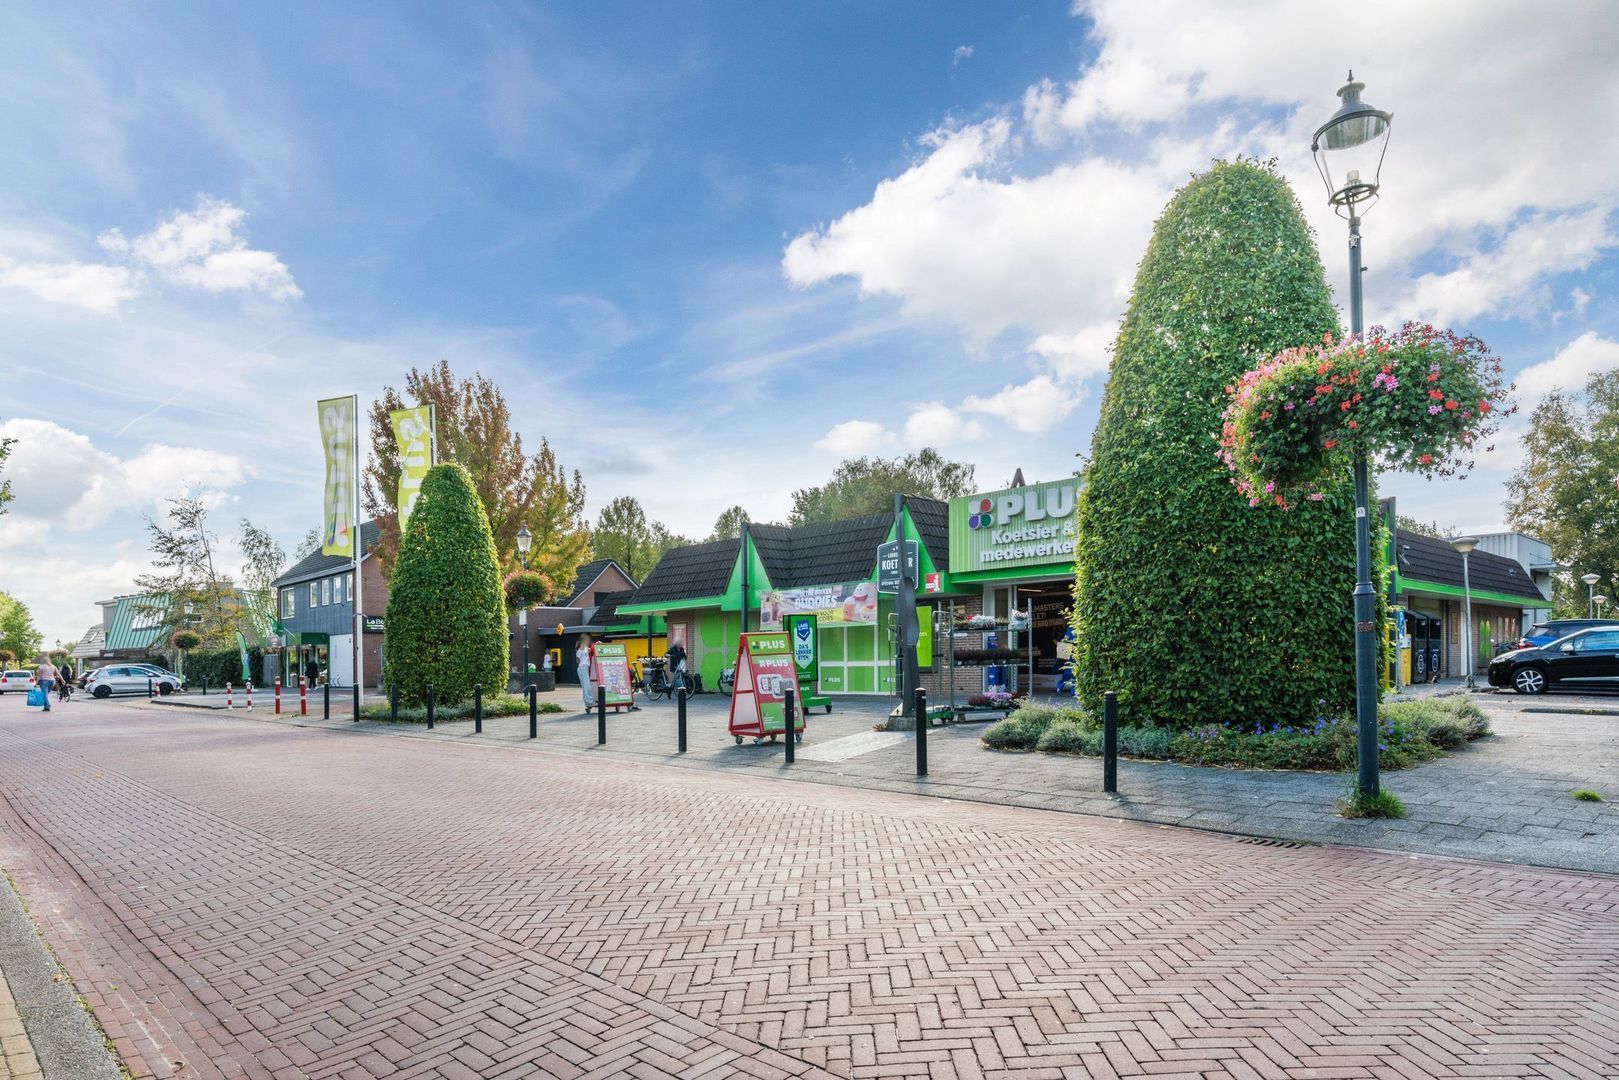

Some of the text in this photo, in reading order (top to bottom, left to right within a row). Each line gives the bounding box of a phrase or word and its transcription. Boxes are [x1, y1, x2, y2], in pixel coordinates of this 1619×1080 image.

[997, 483, 1086, 525] PLU
[992, 519, 1075, 545] Koetsier &
[794, 594, 838, 609] BUDDIES
[760, 640, 785, 649] PLUS
[766, 659, 789, 667] PLUS
